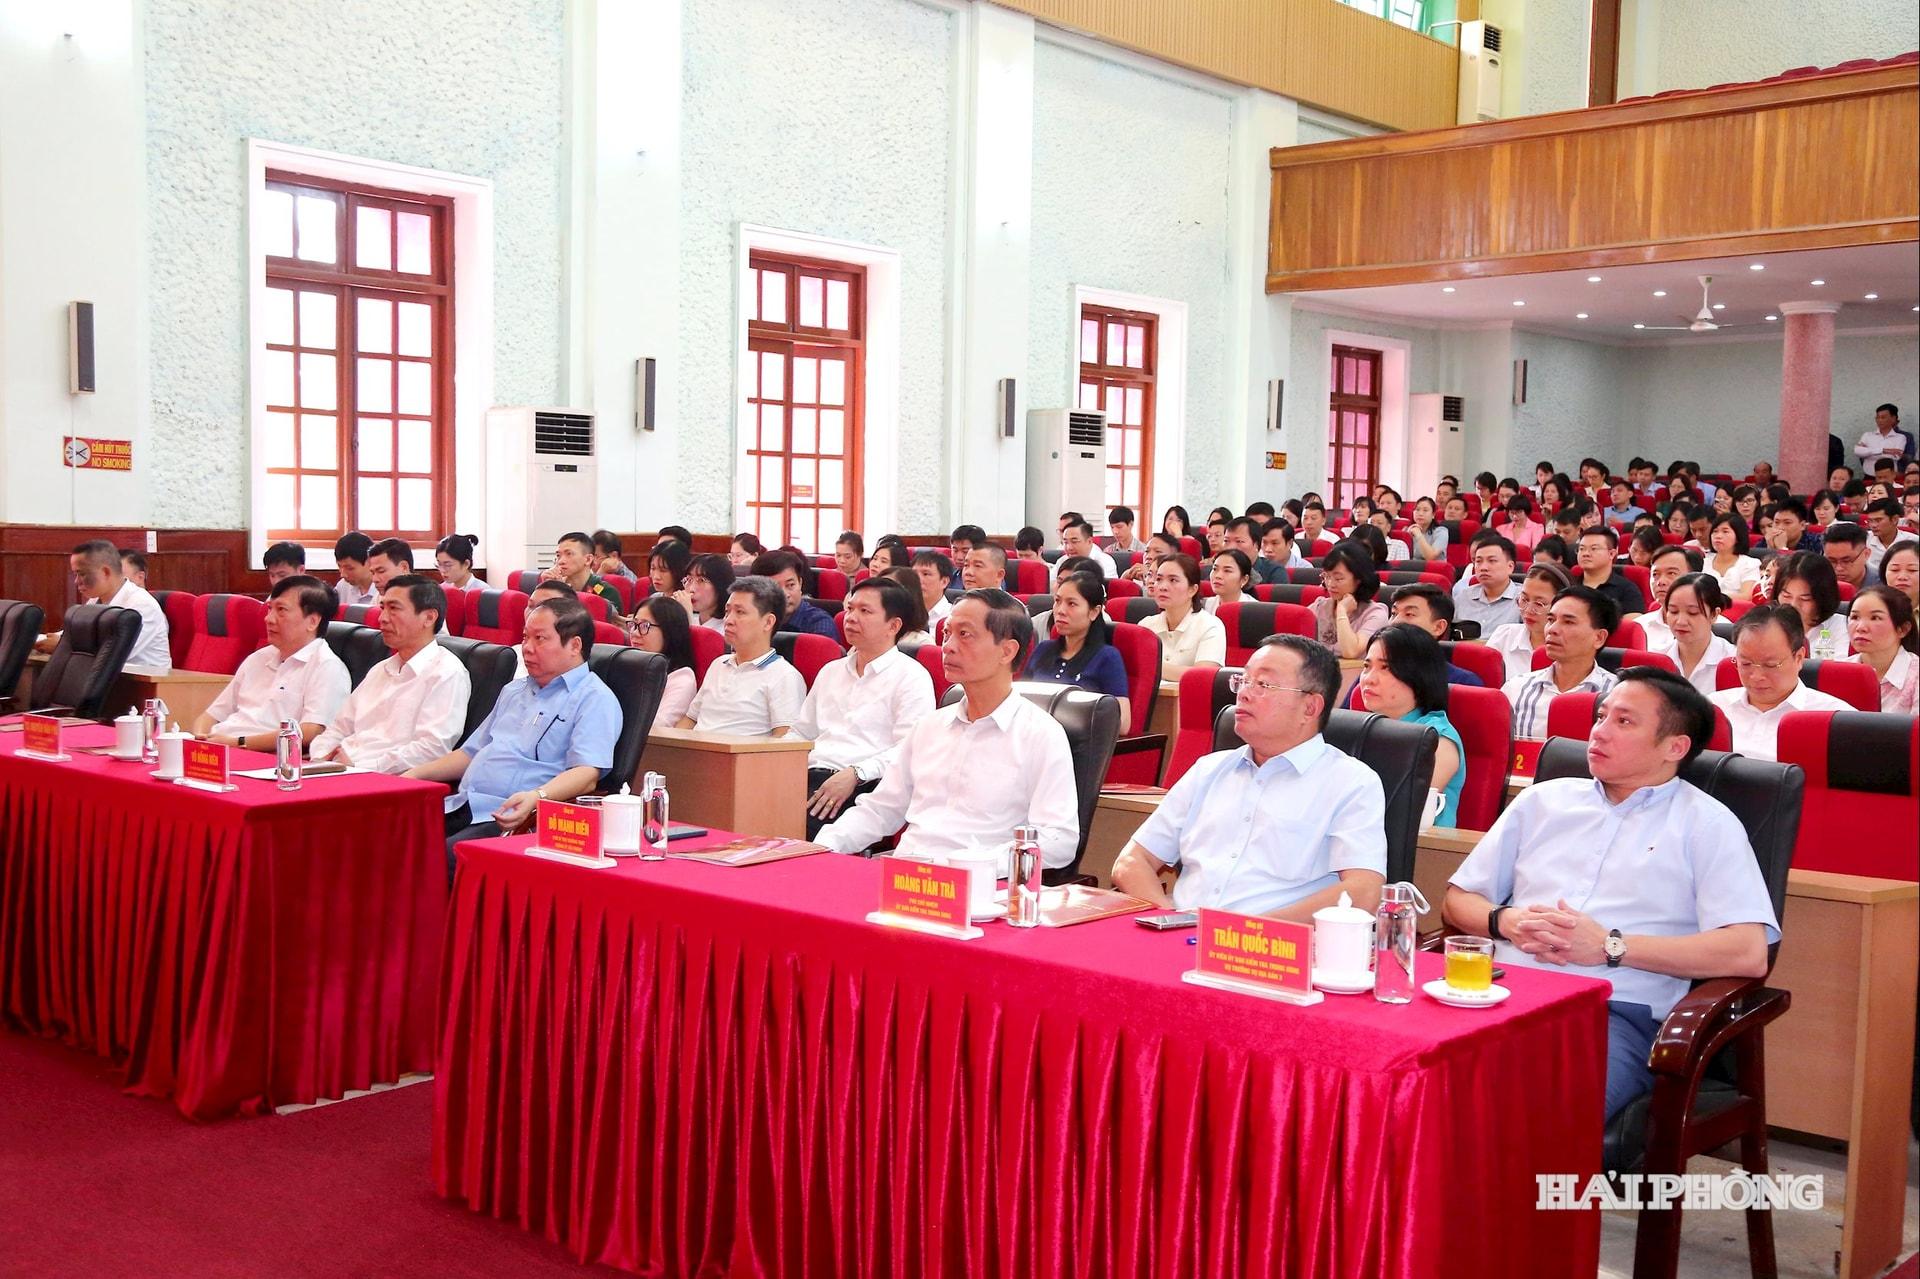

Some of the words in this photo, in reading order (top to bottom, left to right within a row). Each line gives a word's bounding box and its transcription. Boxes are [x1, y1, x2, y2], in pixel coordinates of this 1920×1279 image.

[92, 457, 101, 467] NO
[102, 458, 131, 468] SMOKING
[1516, 754, 1523, 769] 2
[894, 873, 920, 894] HOÀNG
[922, 877, 938, 896] VĂN
[1242, 931, 1269, 955] QUỐC
[1271, 937, 1296, 960] BÌNH
